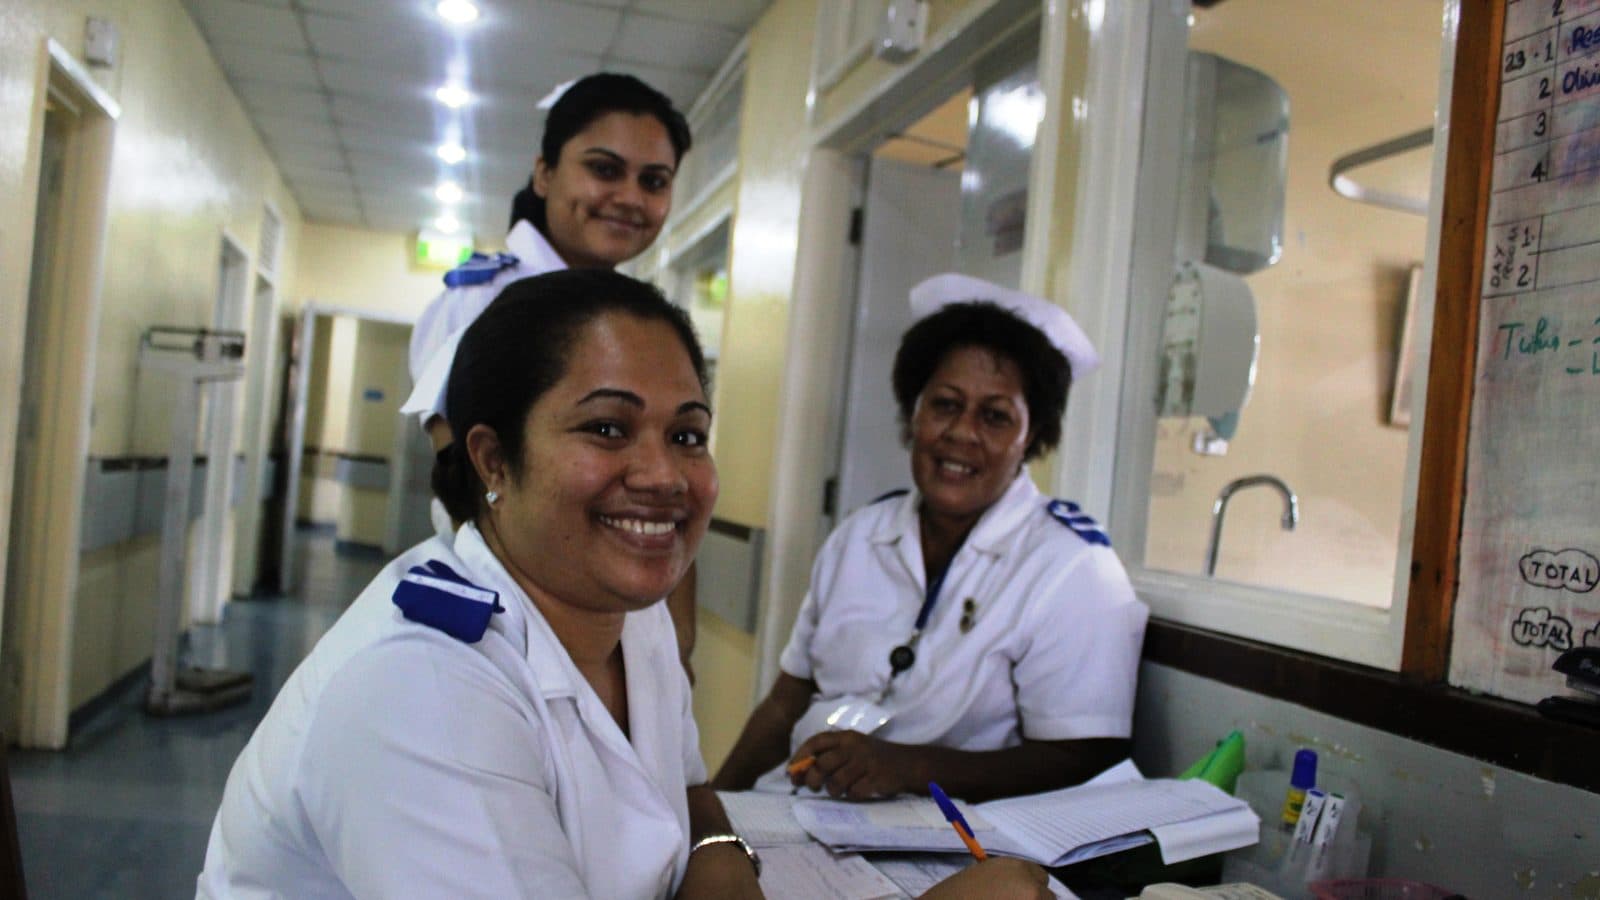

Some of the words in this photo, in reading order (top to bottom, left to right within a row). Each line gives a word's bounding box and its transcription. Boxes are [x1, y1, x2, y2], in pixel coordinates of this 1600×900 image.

[1539, 77, 1551, 99] 2
[1534, 112, 1546, 136] 3
[1531, 161, 1547, 182] 4
[1531, 560, 1594, 586] TOTAL
[1522, 620, 1566, 644] TOTAL
